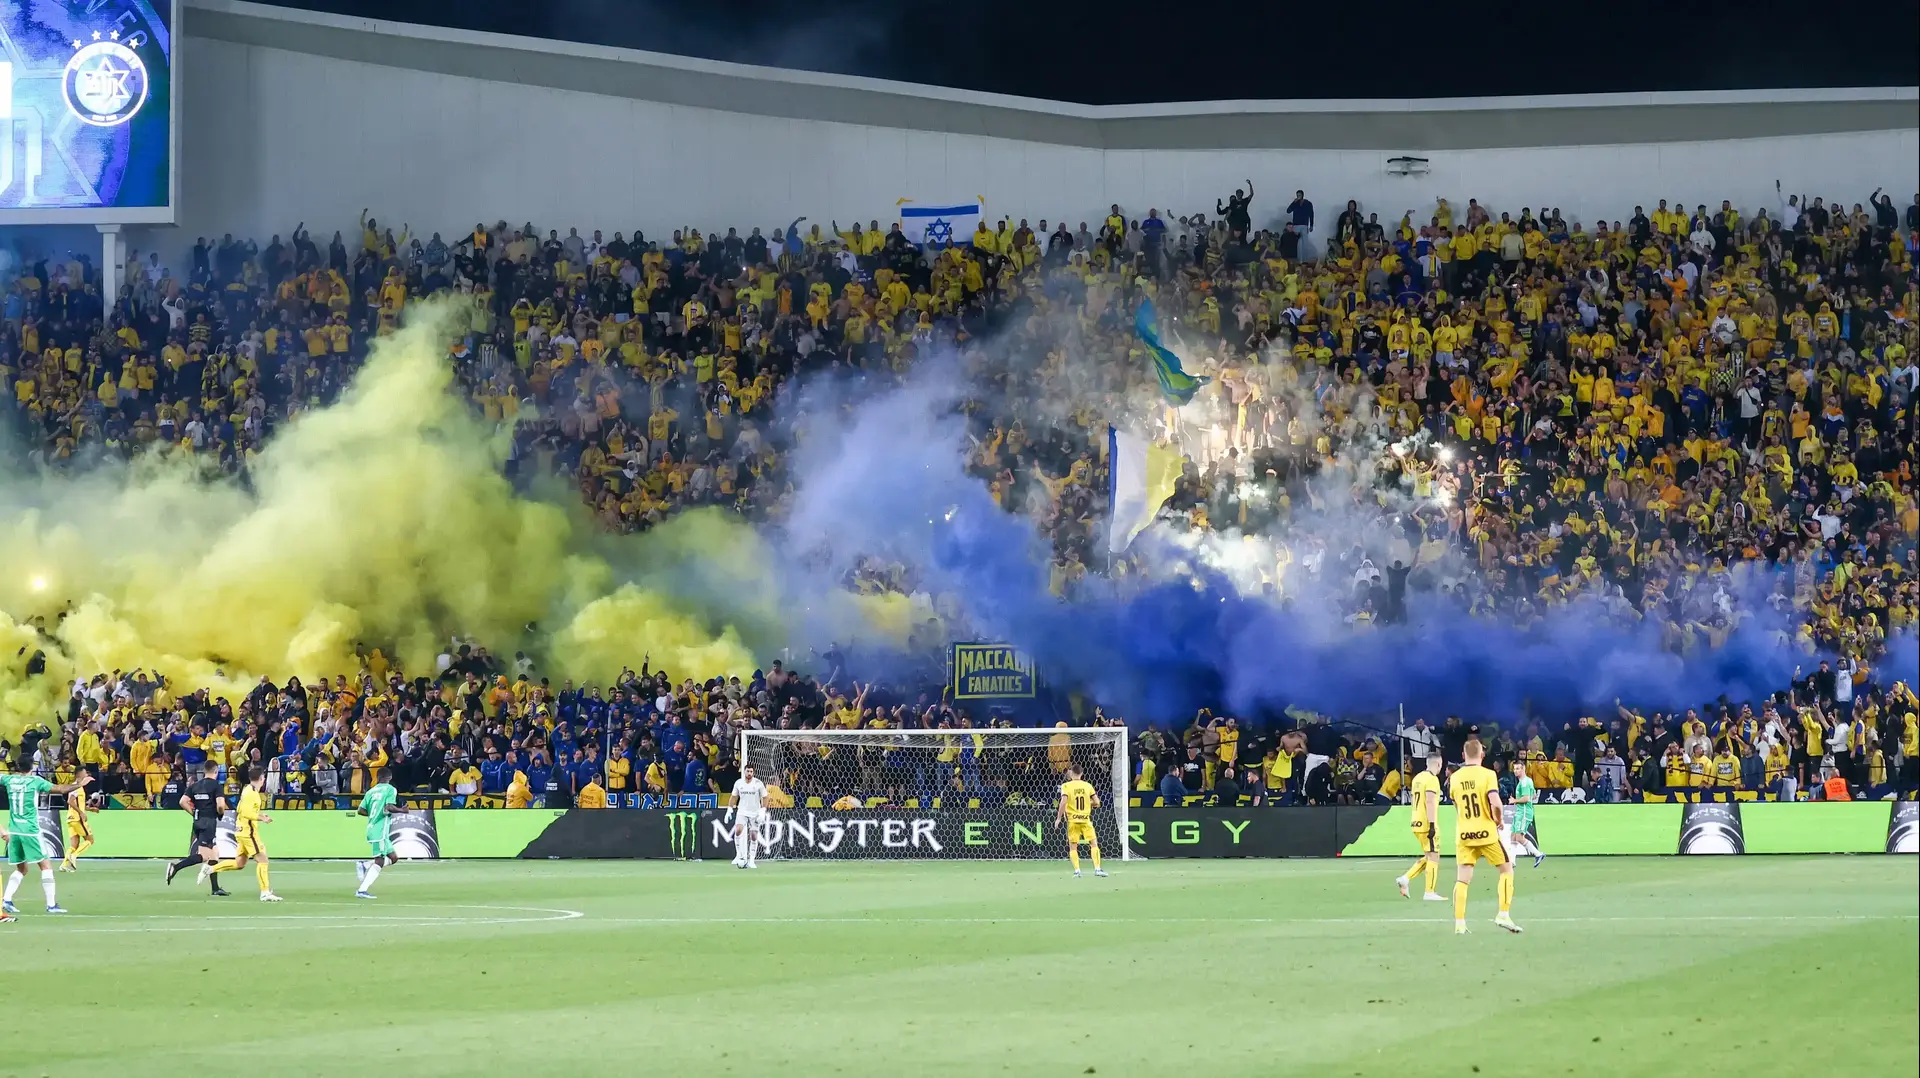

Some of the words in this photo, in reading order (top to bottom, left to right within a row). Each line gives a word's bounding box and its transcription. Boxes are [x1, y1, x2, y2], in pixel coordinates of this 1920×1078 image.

[968, 675, 1022, 692] FANATICS
[1460, 780, 1475, 791] שחר
[1075, 796, 1085, 811] 10
[1462, 793, 1480, 819] 36
[964, 821, 1250, 845] ENRGY
[1460, 830, 1489, 840] CARGO
